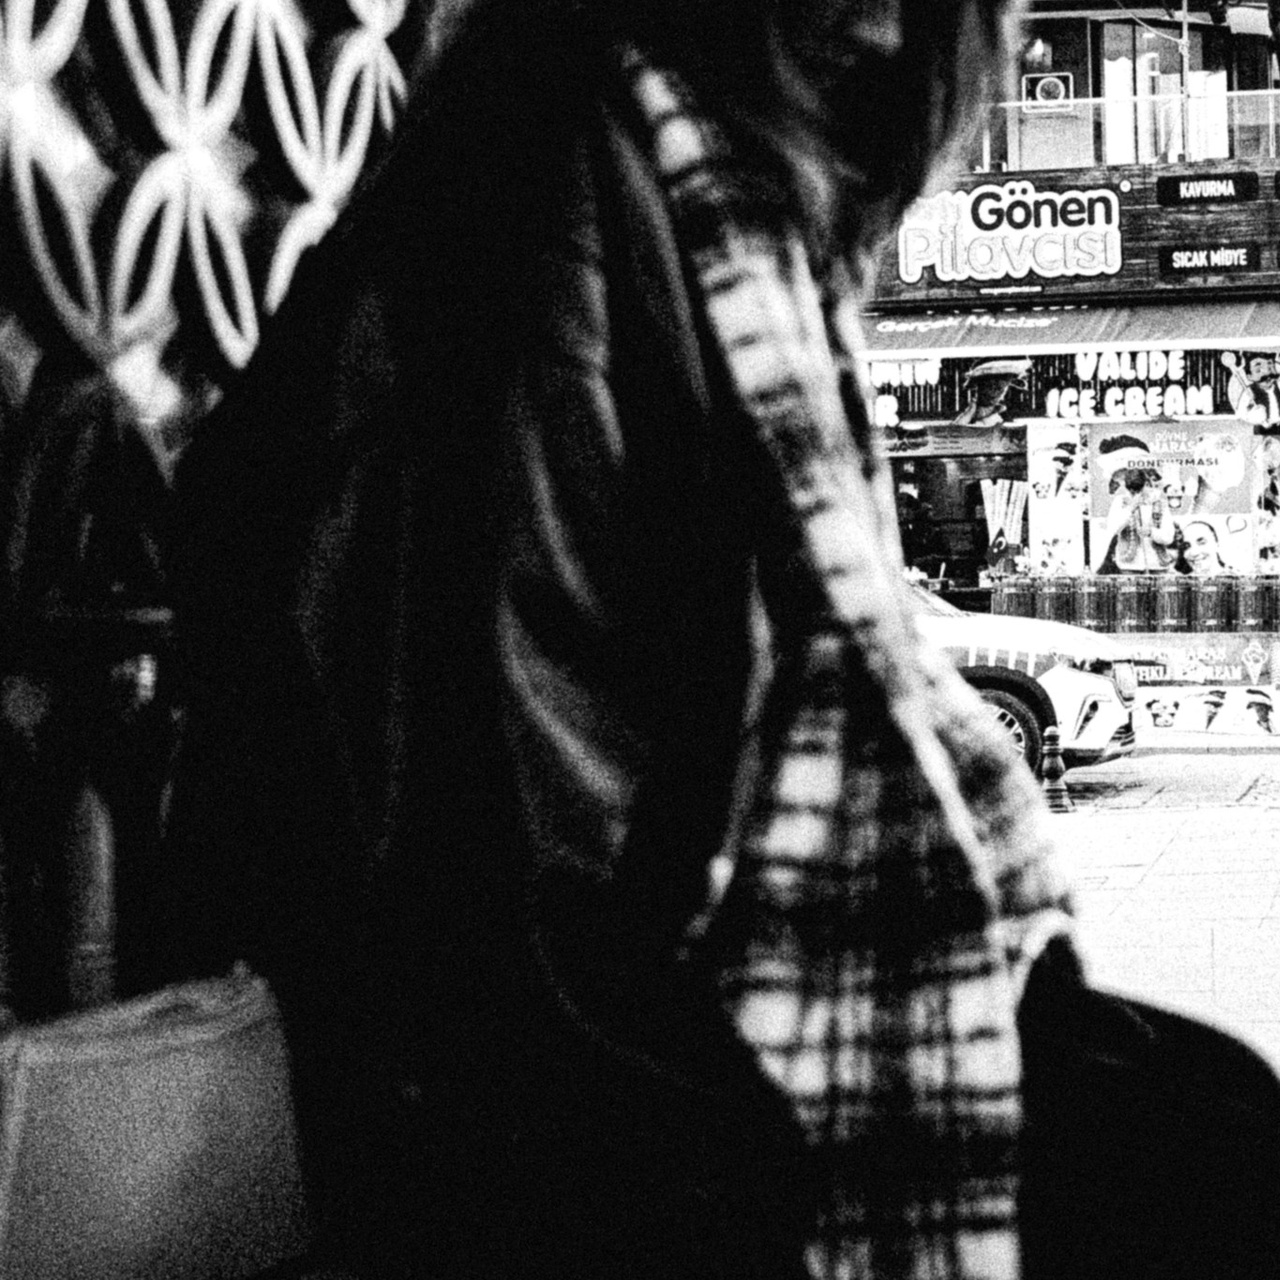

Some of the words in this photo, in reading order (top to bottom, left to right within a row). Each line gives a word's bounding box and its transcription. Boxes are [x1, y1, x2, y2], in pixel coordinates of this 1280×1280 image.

[1179, 179, 1235, 199] KAVURMA
[971, 188, 1113, 231] Gönen
[1172, 251, 1208, 269] SICAK
[1075, 350, 1185, 381] VALIDE
[1044, 386, 1098, 418] ICE
[1104, 384, 1213, 418] CREAM
[1127, 458, 1219, 468] DONDRMASI
